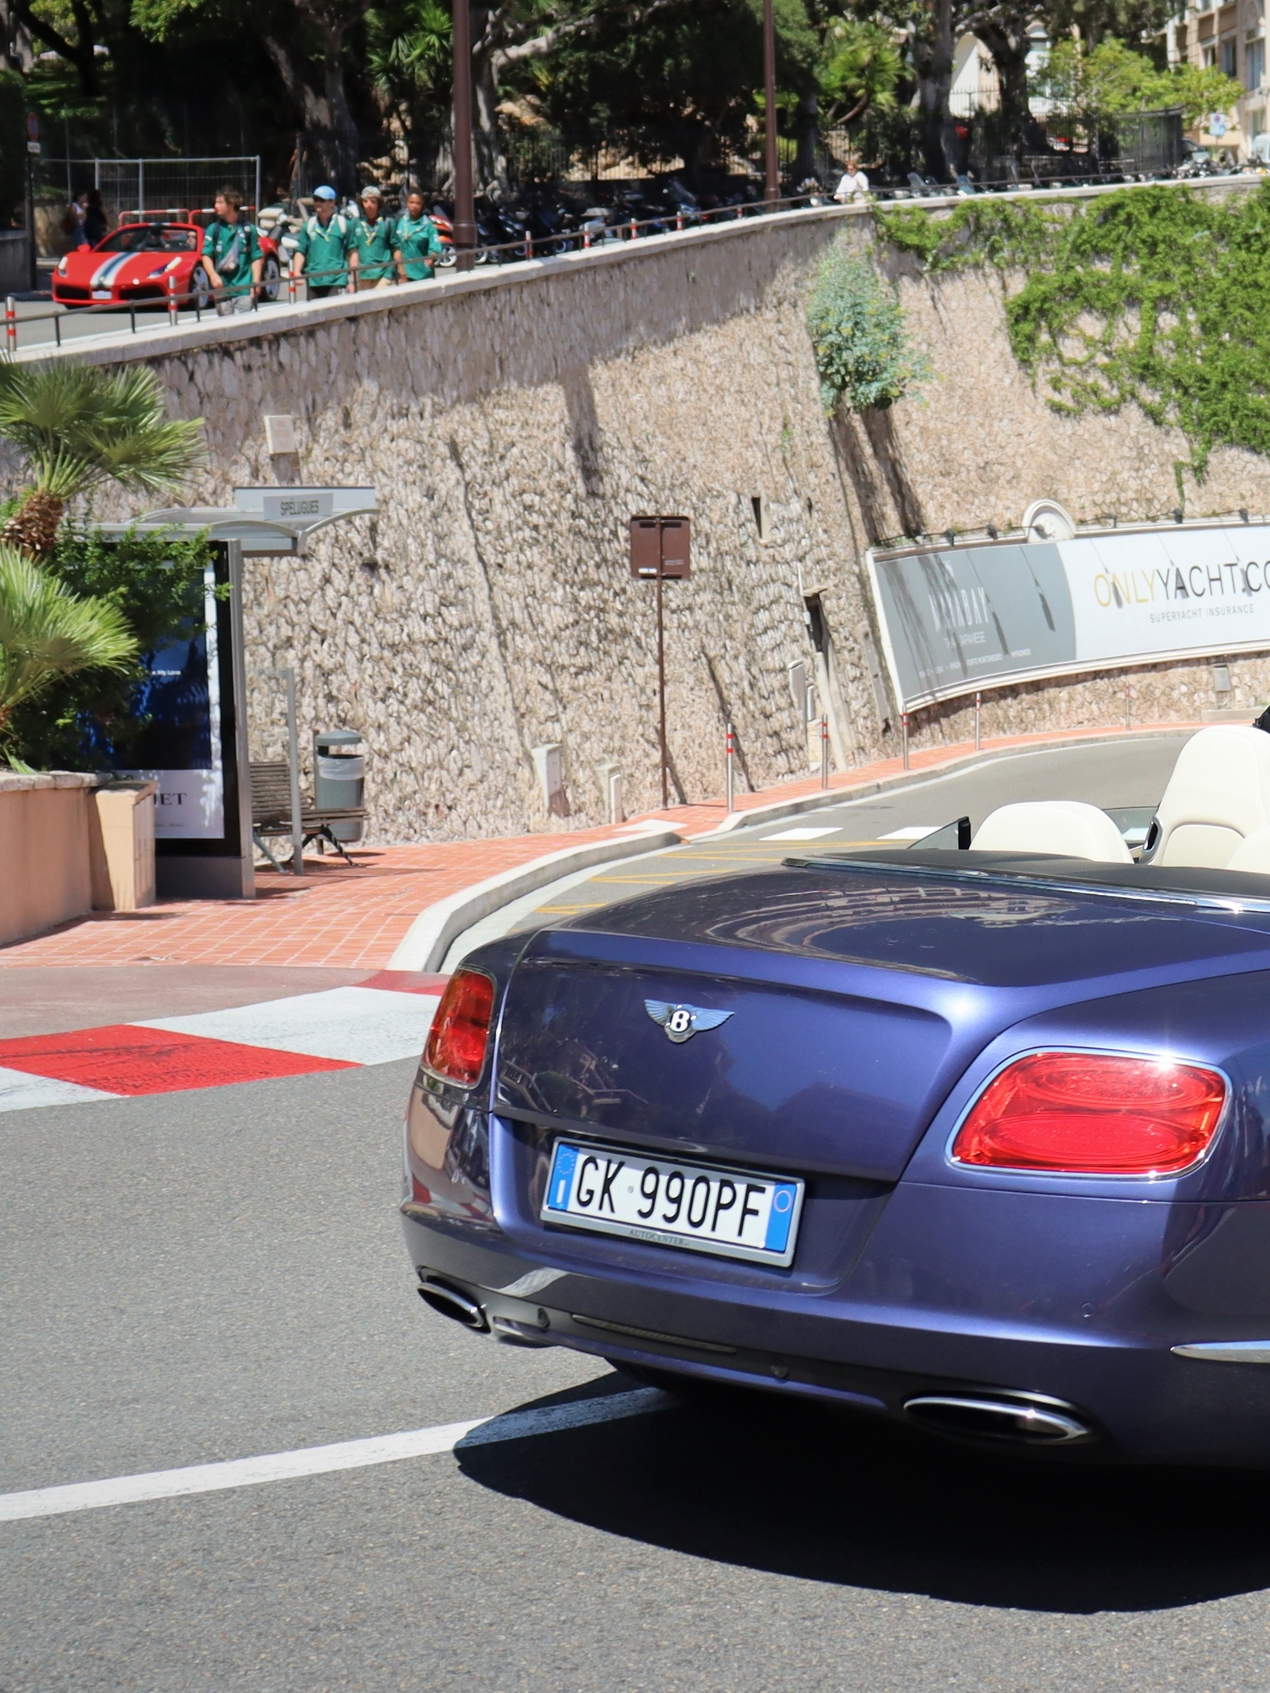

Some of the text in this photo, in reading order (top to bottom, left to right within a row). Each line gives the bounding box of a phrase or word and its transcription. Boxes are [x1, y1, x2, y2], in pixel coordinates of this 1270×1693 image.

[1149, 603, 1255, 624] SUPERYACHT INSURANCE
[576, 1155, 766, 1237] GK 990PF
